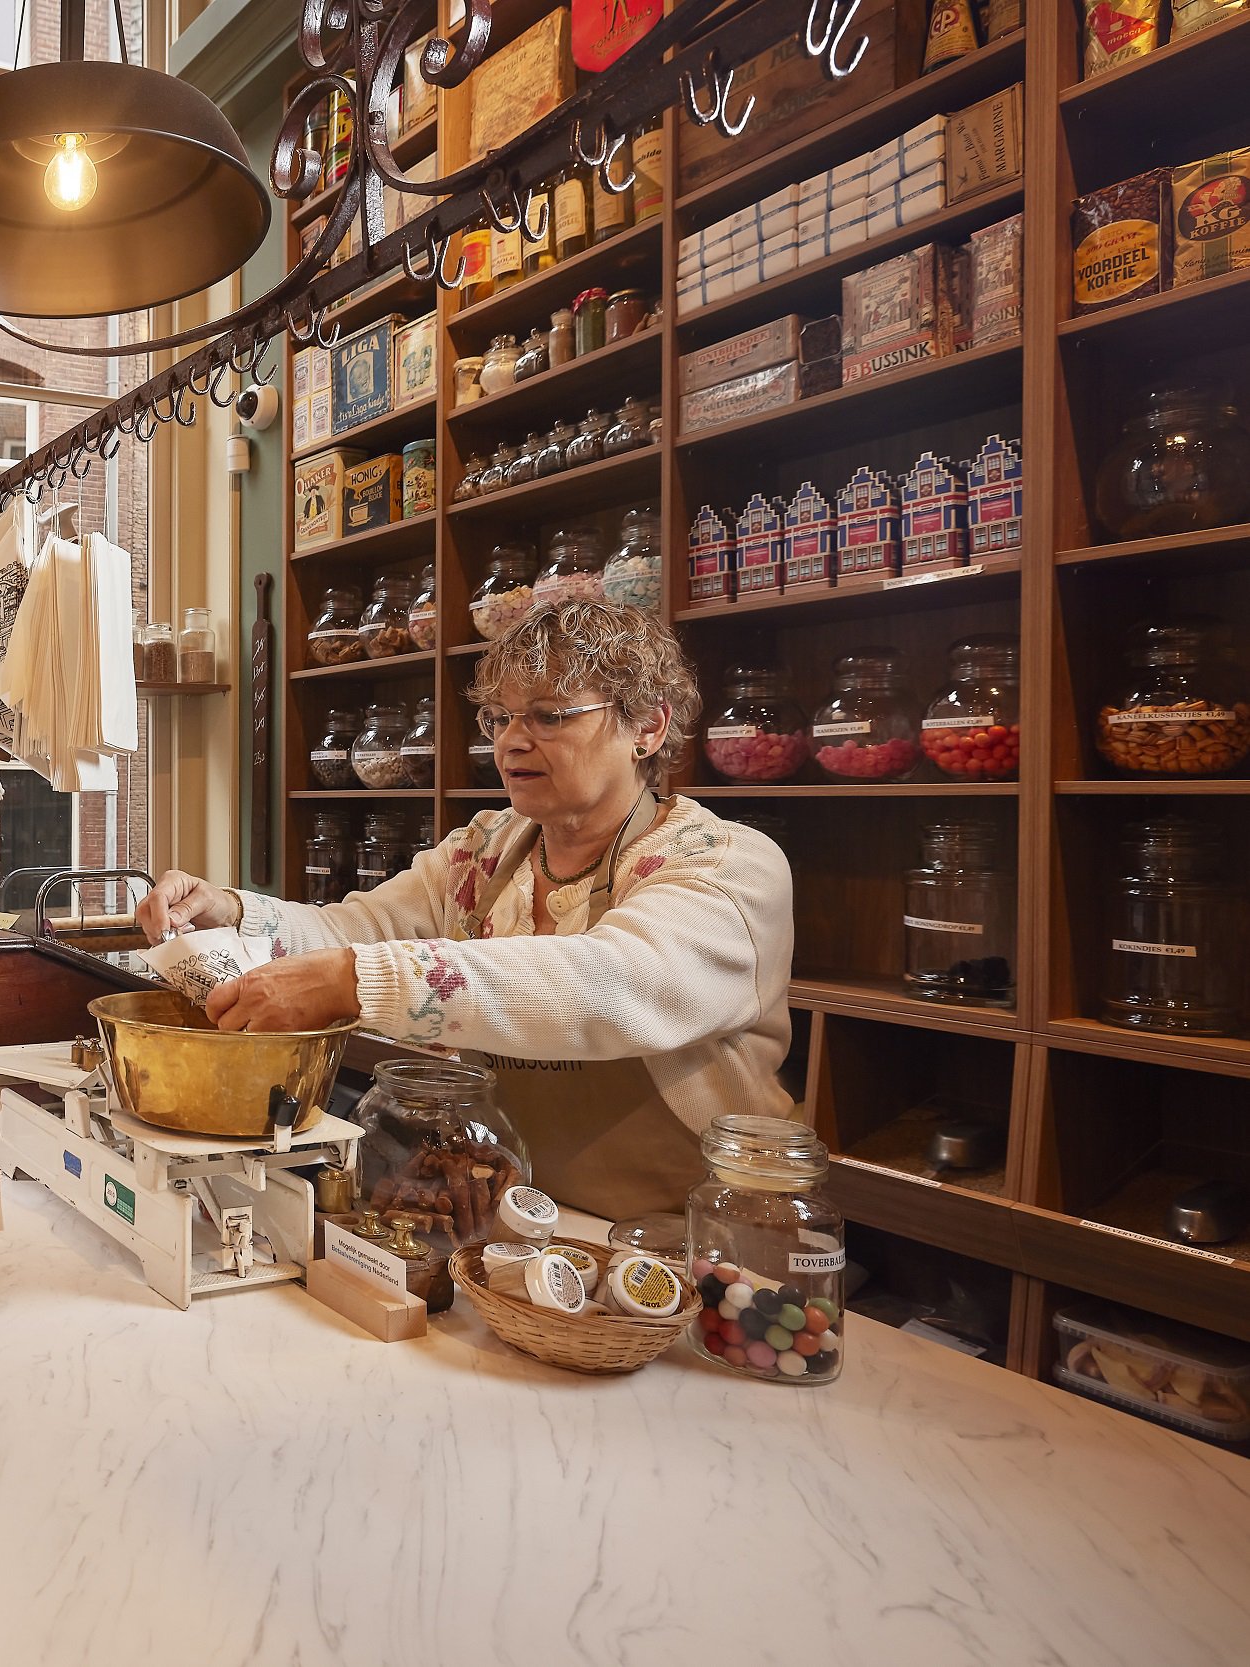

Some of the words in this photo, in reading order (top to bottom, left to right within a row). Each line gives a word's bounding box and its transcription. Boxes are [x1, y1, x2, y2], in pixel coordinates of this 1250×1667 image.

[992, 101, 1007, 174] MARGARINE
[1188, 215, 1247, 241] KOFFIE
[1194, 205, 1242, 229] KG
[1077, 247, 1151, 281] VOORDEEL
[1087, 264, 1138, 292] KOFFIE
[341, 333, 380, 368] LIGA
[860, 340, 931, 378] BUSSINK
[295, 466, 332, 499] QUAKER
[1116, 711, 1203, 721] KANEELKUSSENTJES
[1119, 943, 1162, 952] KOKINDJES
[331, 1244, 372, 1273] Betaalvereniging
[372, 1266, 399, 1286] Nederland
[338, 1239, 358, 1256] Mogelijk
[357, 1250, 379, 1267] gemaakt
[378, 1261, 391, 1272] door
[659, 1268, 675, 1295] ZWART
